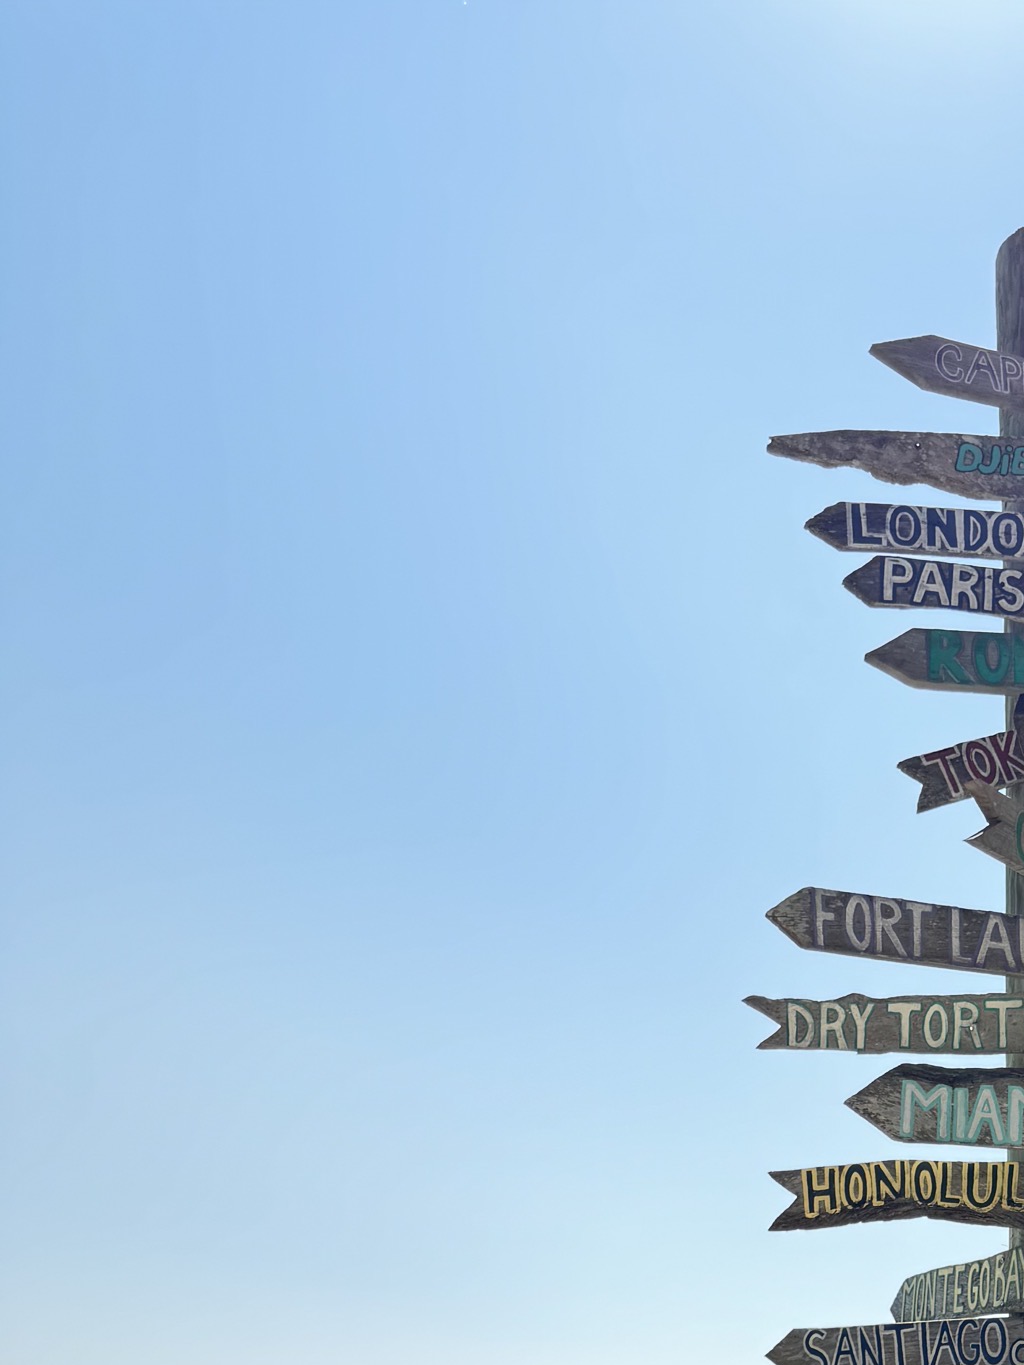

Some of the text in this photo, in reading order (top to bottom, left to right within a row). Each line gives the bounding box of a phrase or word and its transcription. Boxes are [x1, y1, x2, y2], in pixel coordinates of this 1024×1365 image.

[882, 557, 1024, 612] PARIS
[813, 893, 936, 956] FORT
[786, 1000, 874, 1049] DRY
